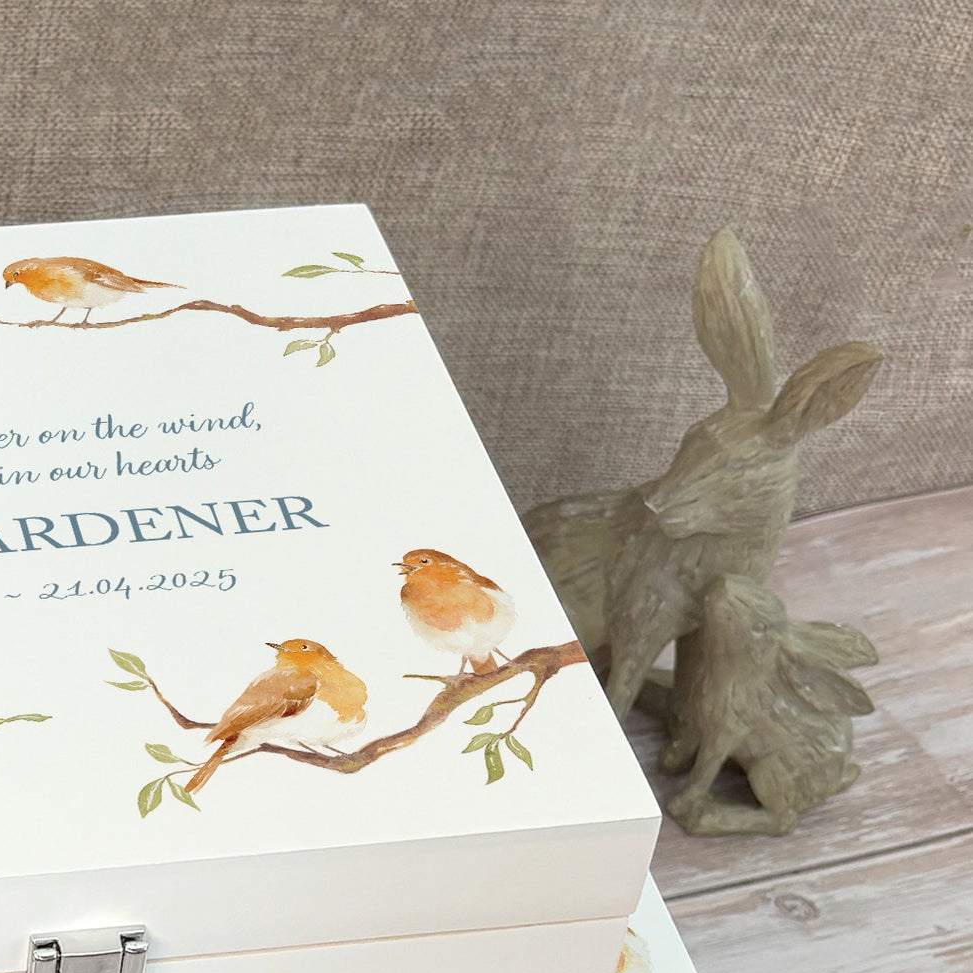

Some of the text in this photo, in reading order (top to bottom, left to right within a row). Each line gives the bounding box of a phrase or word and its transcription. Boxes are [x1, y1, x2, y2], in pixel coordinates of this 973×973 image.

[38, 429, 87, 445] on
[90, 414, 149, 440] the
[157, 402, 262, 435] wind,
[49, 461, 108, 482] our
[116, 446, 222, 477] hearts
[38, 568, 238, 602] 21.04.2025
